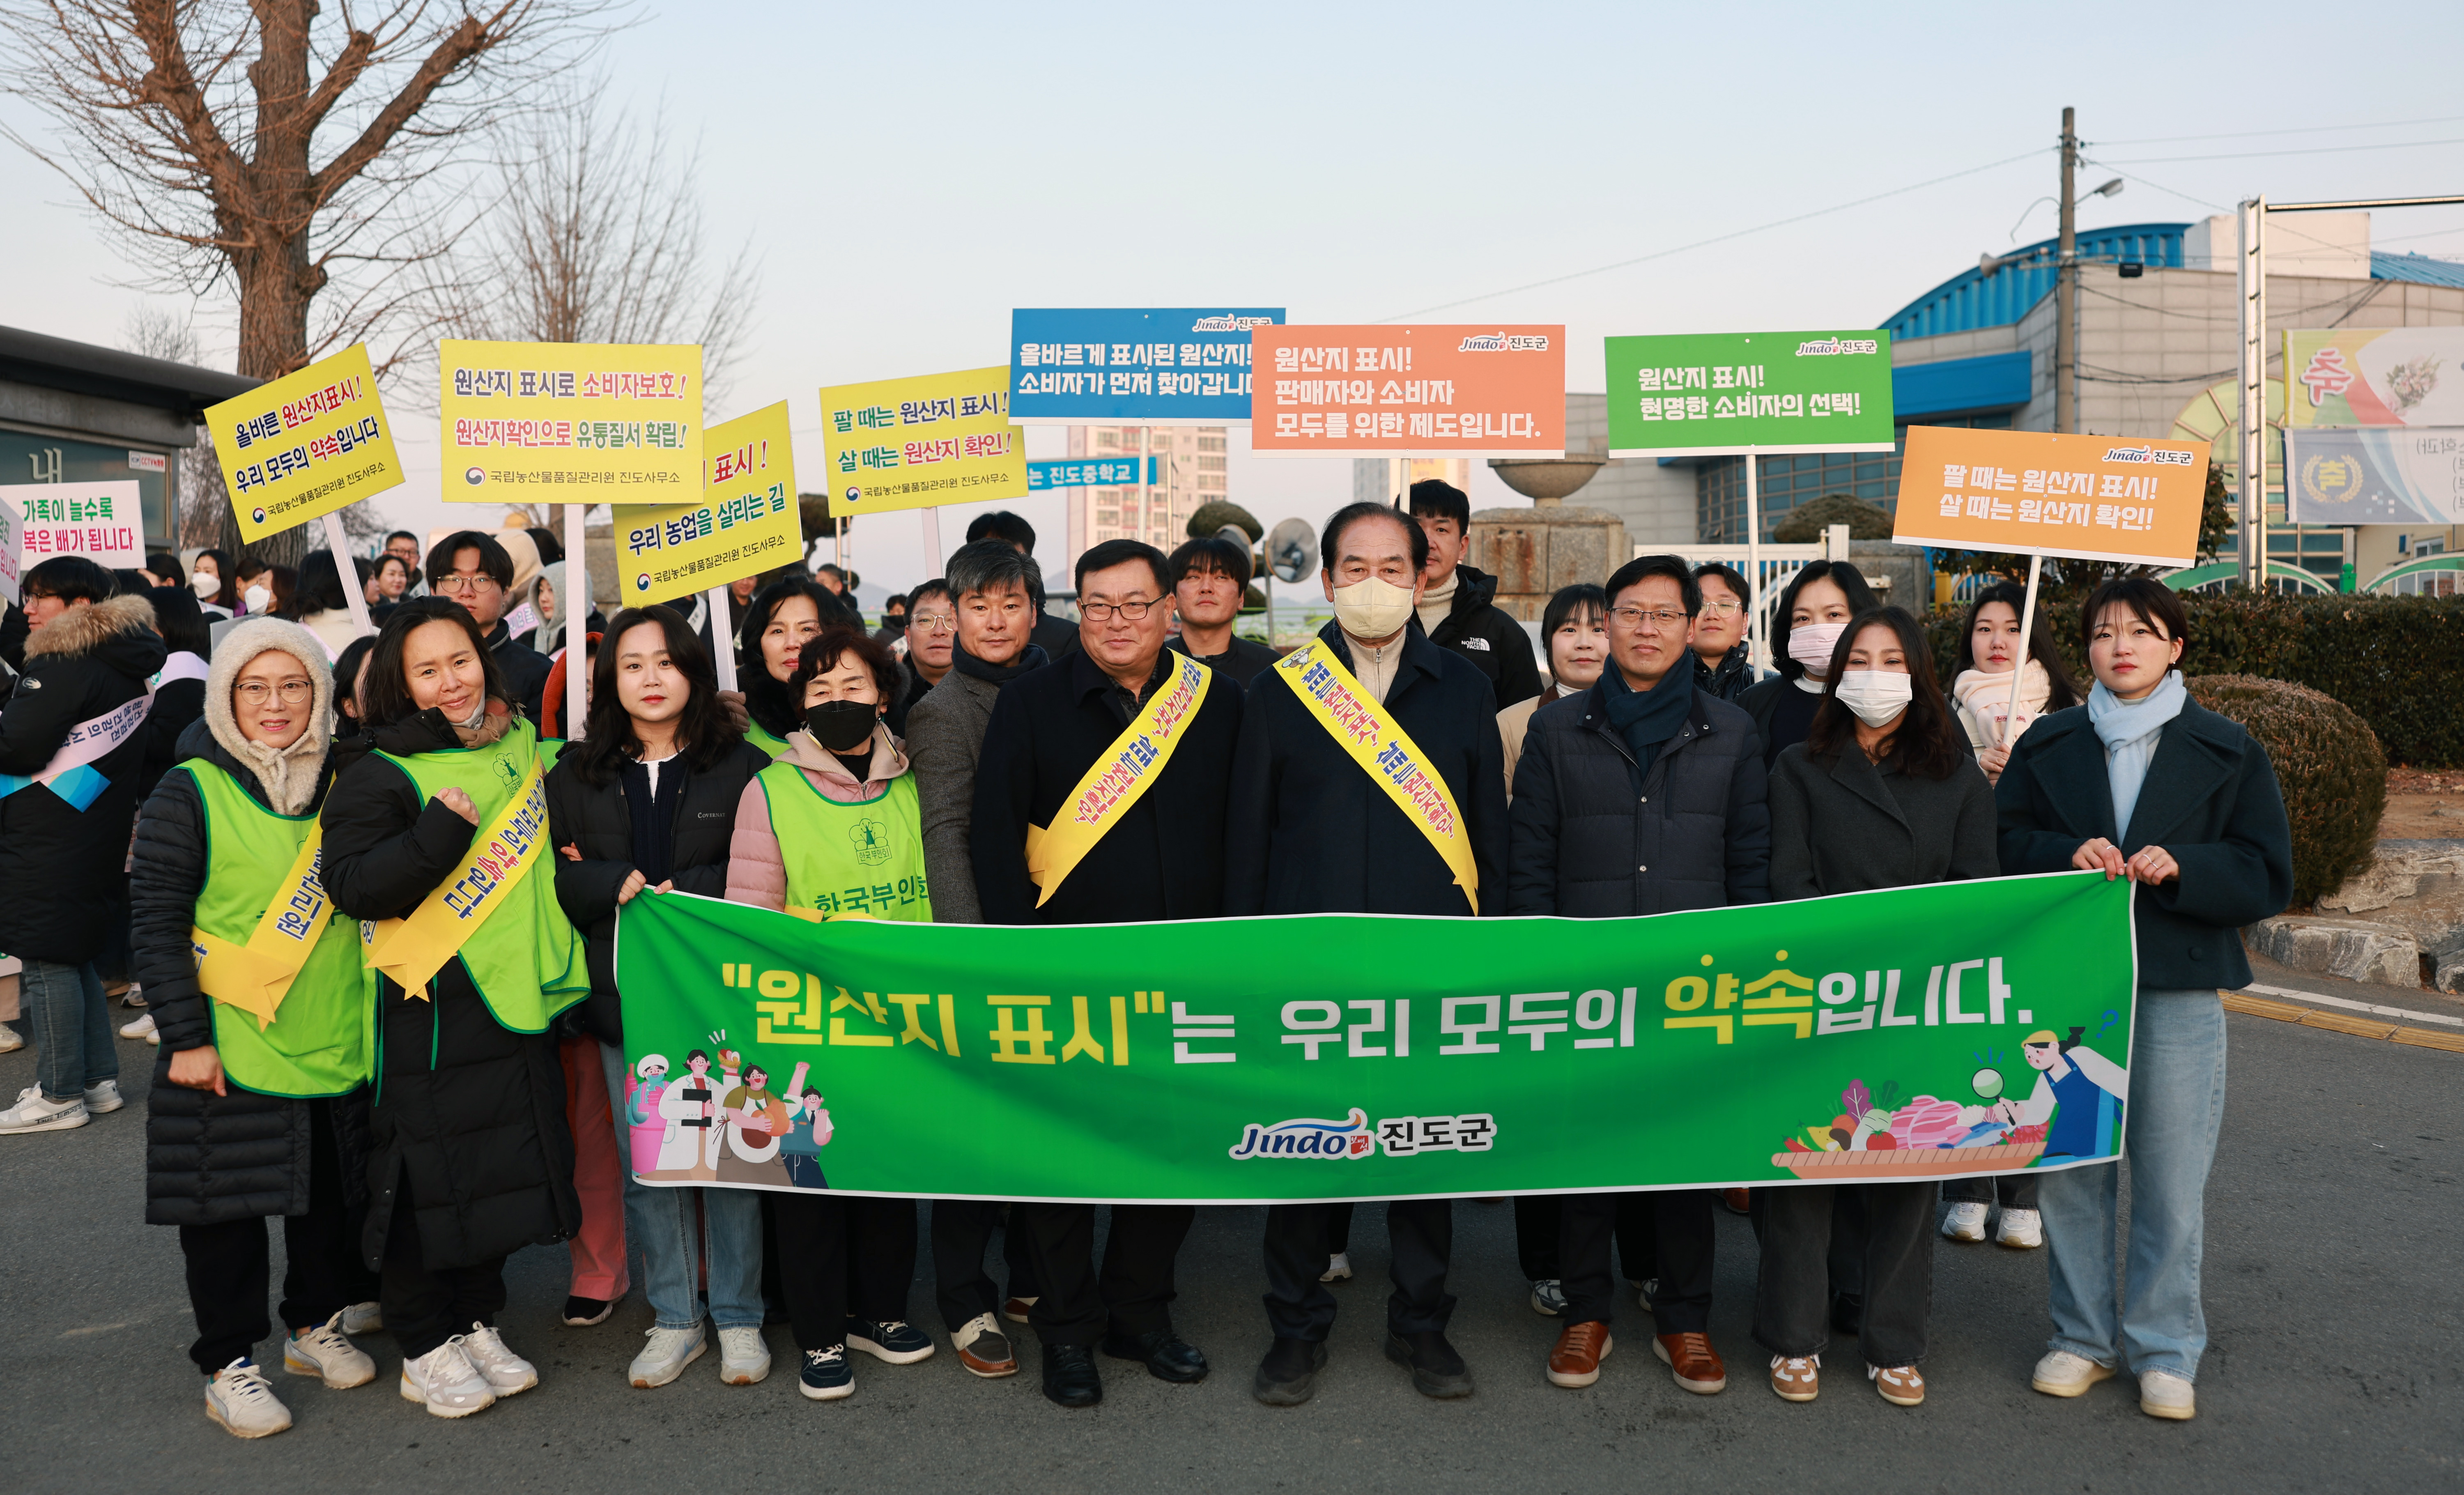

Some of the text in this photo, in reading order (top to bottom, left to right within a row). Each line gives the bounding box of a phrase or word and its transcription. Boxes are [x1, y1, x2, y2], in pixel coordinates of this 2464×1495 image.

[1194, 320, 1228, 330] Jindo
[1020, 343, 1252, 366] 올바르게 표시된 원산지!
[1460, 336, 1499, 350] Jindo
[1509, 337, 1547, 350] 진도군
[1797, 341, 1832, 355] Jindo
[1841, 340, 1876, 353] 진도군
[1275, 347, 1411, 372] 원산지 표시!
[454, 369, 686, 399] 원산지 표시로 소비자보호!
[1018, 372, 1105, 395] 소비자가
[1110, 373, 1152, 396] 먼저
[1638, 366, 1764, 391] 원산지 표시!
[1275, 380, 1455, 405] 판매자와 소비자
[235, 376, 363, 448] 올바른 원산지표시!
[834, 391, 1007, 432] 팔 때는 원산지 표시!
[1640, 393, 1861, 421] 현명한 소비자의 선택!
[456, 419, 687, 449] 원산지확인으로 유통질서 확립!
[1275, 413, 1541, 438] 모두를 위한 제도입니다.
[236, 415, 379, 493] 우리 모두의 약속입니다
[714, 440, 767, 484] 표시!
[838, 432, 1011, 472] 살 때는 원산지 확인!
[2104, 449, 2142, 463] Jindo
[2154, 451, 2192, 465] 진도군
[490, 470, 680, 484] 국립농산물품질관리원 진도사무소
[864, 472, 1009, 498] 국립농산물품질관리원 진도사무소
[1049, 464, 1131, 485] 진도중학교
[1944, 464, 2158, 500] 팔 때는 원산지 표시!
[267, 462, 386, 515] 국립농산물품질관리원 진도사무소
[23, 497, 114, 522] 가족이 늘수록
[629, 482, 785, 556] 우리 농업을 살리는 길
[1940, 494, 2154, 531] 살 때는 원산지 확인!
[23, 527, 133, 554] 복은 배가 됩니다
[0, 546, 17, 583] 입니다
[653, 535, 786, 584] 국립농산물품질관리원 진도사무소
[87, 713, 123, 738] 건강의
[499, 807, 539, 857] 모두의
[859, 848, 890, 861] 한국부인회
[442, 841, 519, 920] 약속입니다
[722, 950, 2034, 1067] "원산지 표시"는 우리 모두의 약속입니다.
[55, 1102, 83, 1120] TEMPER
[1235, 1125, 1350, 1158] Jindo
[1381, 1117, 1492, 1152] 진도군
